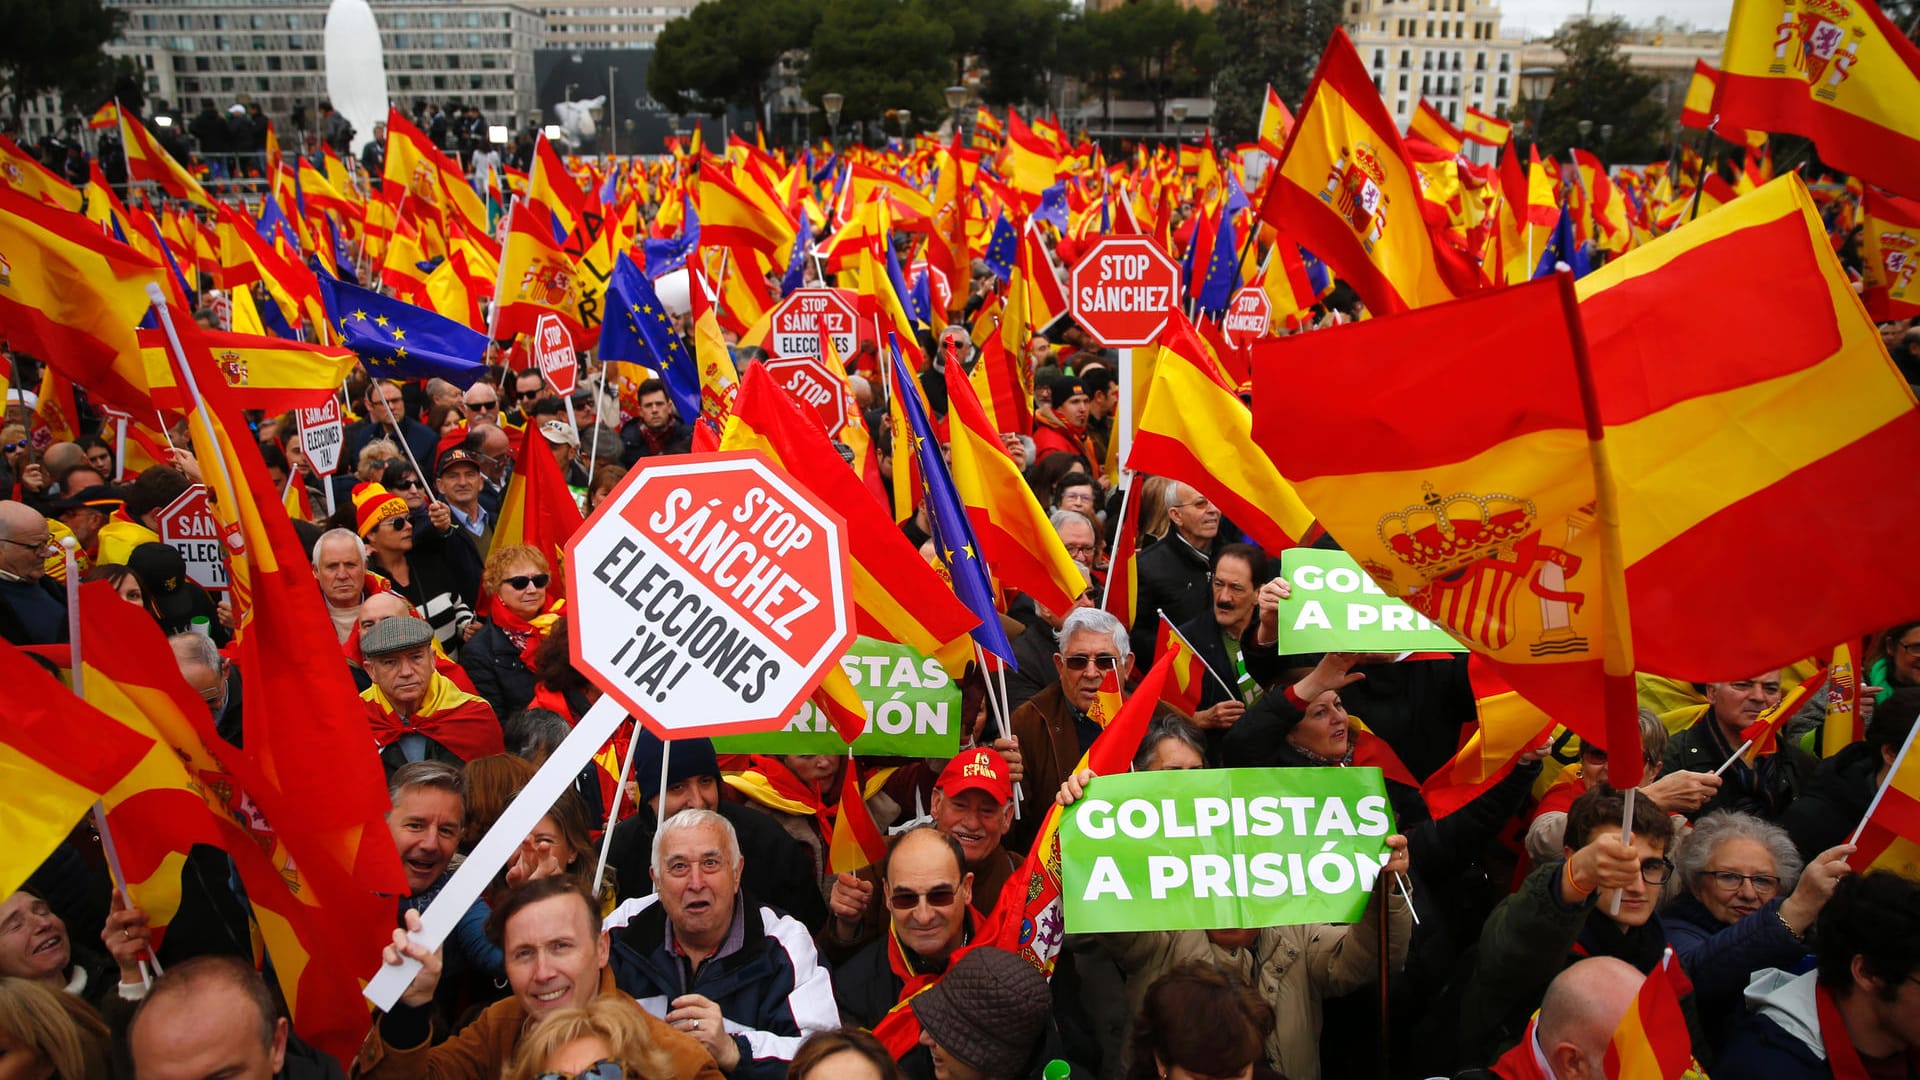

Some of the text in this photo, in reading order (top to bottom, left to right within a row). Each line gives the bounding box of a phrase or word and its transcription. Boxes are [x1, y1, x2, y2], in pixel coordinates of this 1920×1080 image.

[1100, 254, 1150, 280] STOP
[801, 298, 828, 312] STOP
[1081, 280, 1169, 312] SÁNCHEZ
[1238, 296, 1260, 312] STOP
[544, 326, 562, 347] STOP
[1227, 311, 1265, 332] SÁNCHEZ
[543, 346, 574, 373] SÁNCHEZ
[783, 336, 849, 353] ELECCIES
[786, 369, 832, 409] STOP
[306, 425, 340, 452] ELECCIONES
[178, 511, 217, 537] SÁN
[733, 487, 812, 557] STOP
[649, 488, 821, 641] SÁNCHEZ
[1292, 565, 1387, 595] GOL
[592, 536, 780, 703] ELECCIONES
[1293, 599, 1442, 632] A PRI
[610, 625, 691, 703] ¡YA!
[839, 655, 949, 689] STAS
[781, 691, 949, 735] RIIÓN
[1075, 795, 1390, 840] GOLPISTAS
[1082, 841, 1392, 901] A PRISIÓN
